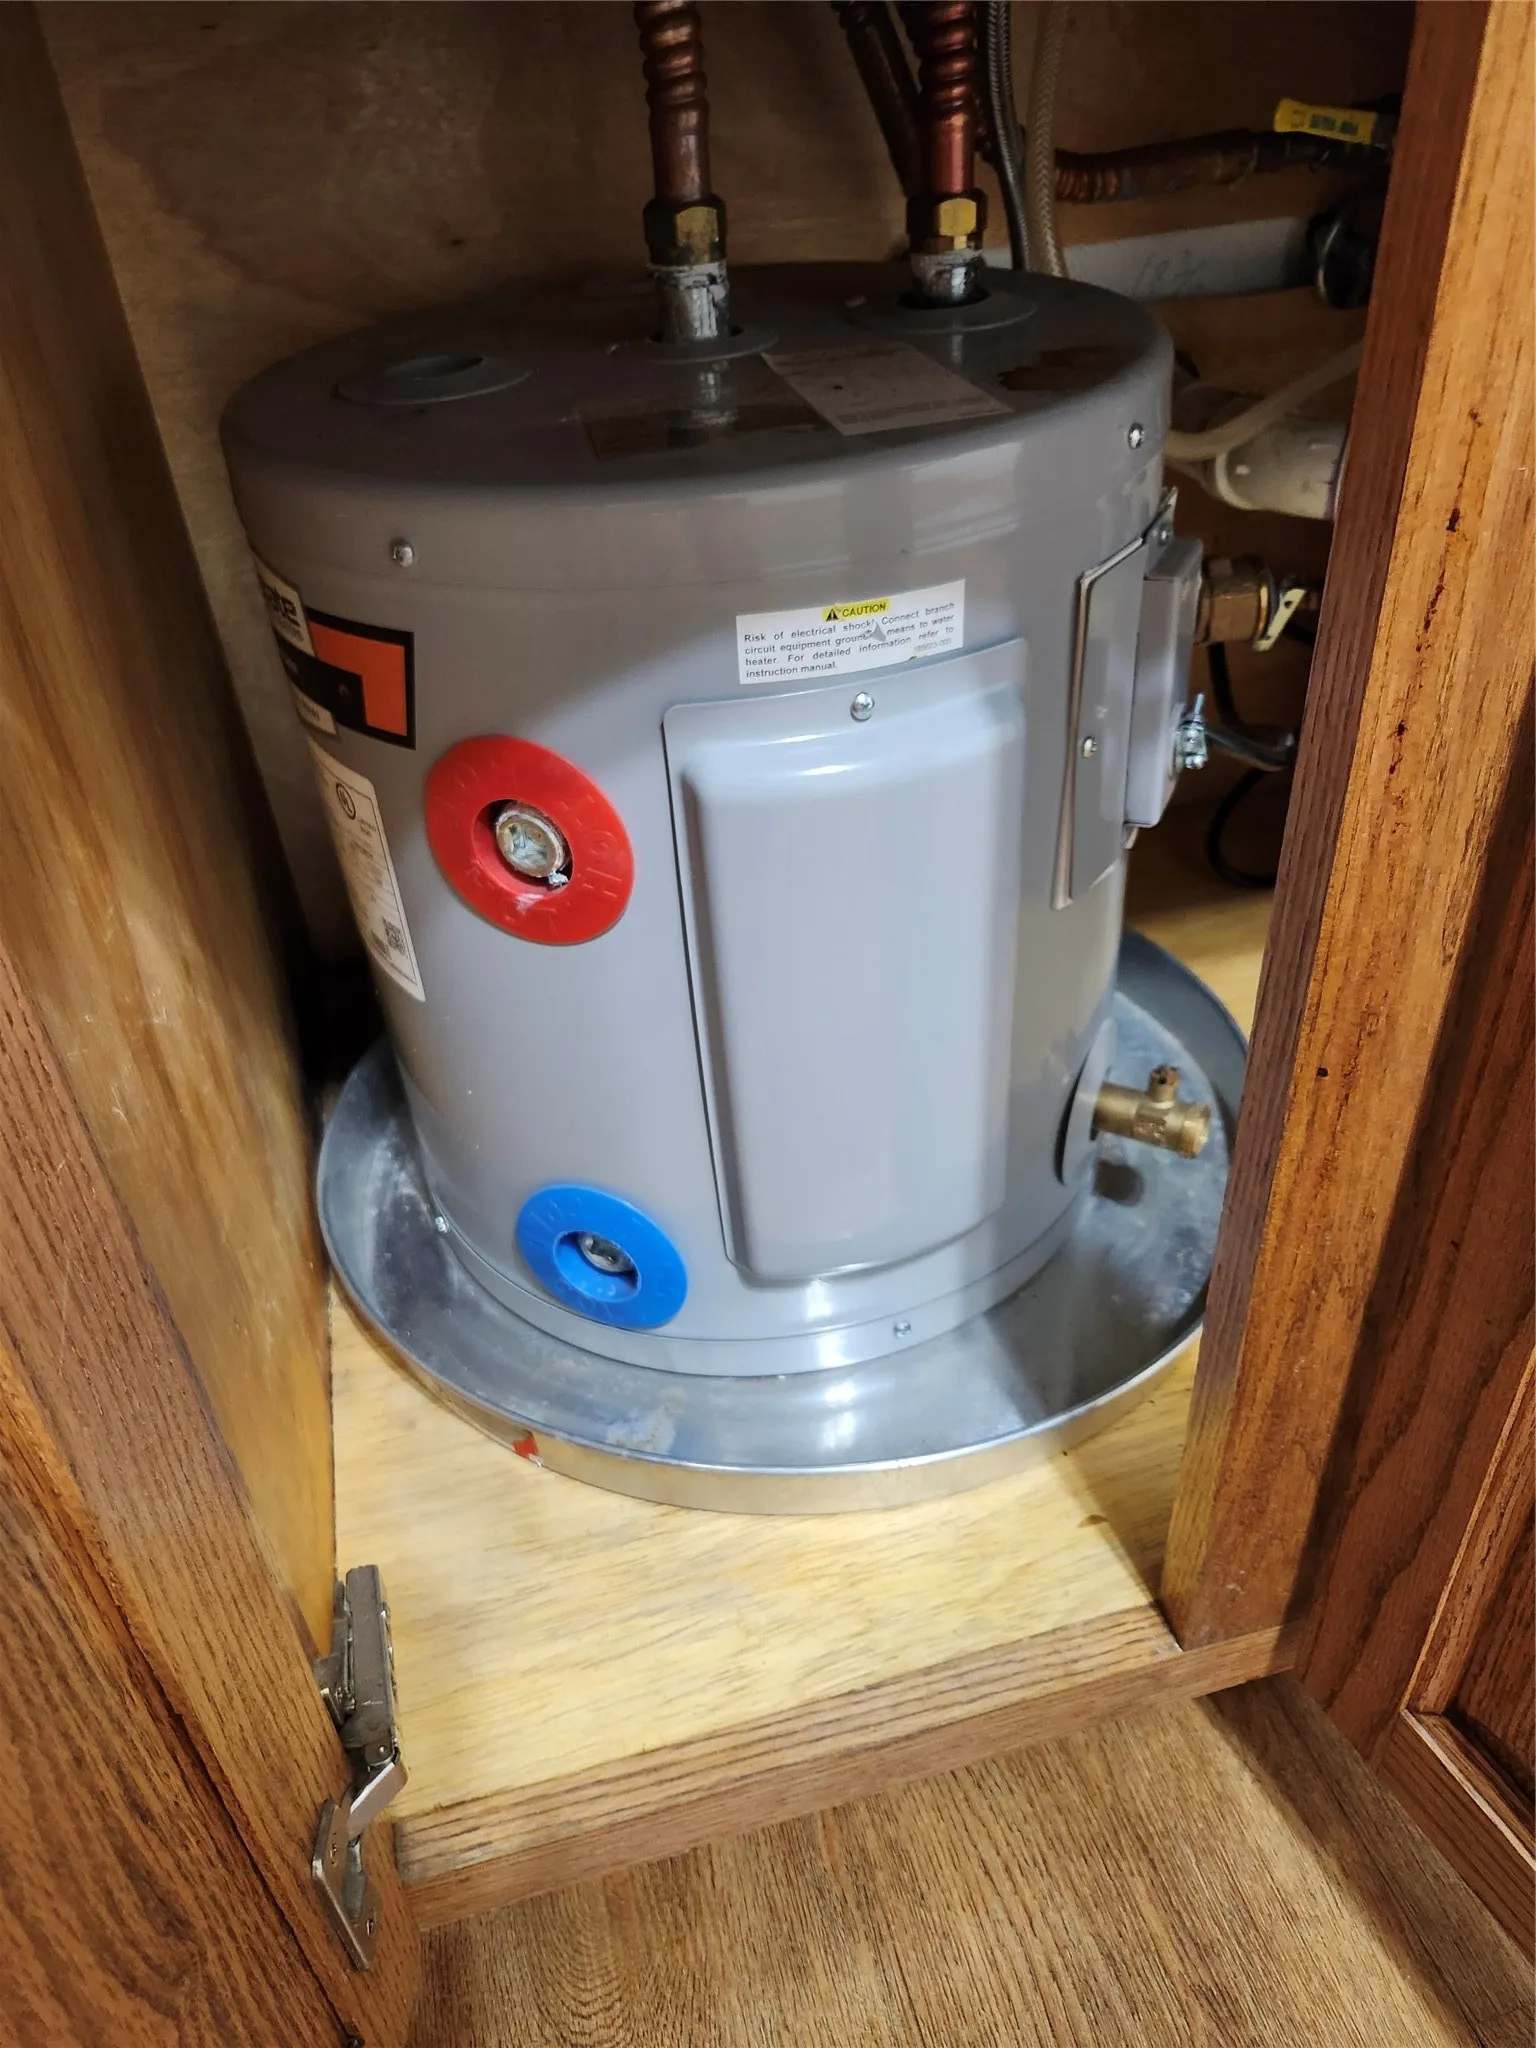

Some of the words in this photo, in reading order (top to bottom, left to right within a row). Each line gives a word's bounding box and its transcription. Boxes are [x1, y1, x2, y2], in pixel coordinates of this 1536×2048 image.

[744, 634, 766, 642] Risk
[791, 626, 836, 638] electrical
[882, 611, 919, 625] Connect
[925, 602, 954, 615] branch
[842, 603, 887, 618] CAUTION
[745, 645, 776, 654] circuit
[780, 639, 831, 651] equipment
[887, 624, 915, 635] means
[920, 619, 928, 628] to
[932, 614, 955, 625] water
[788, 654, 804, 663] For
[813, 648, 850, 660] detailed
[859, 637, 911, 652] information
[919, 630, 939, 641] refer
[746, 667, 798, 677] instruction
